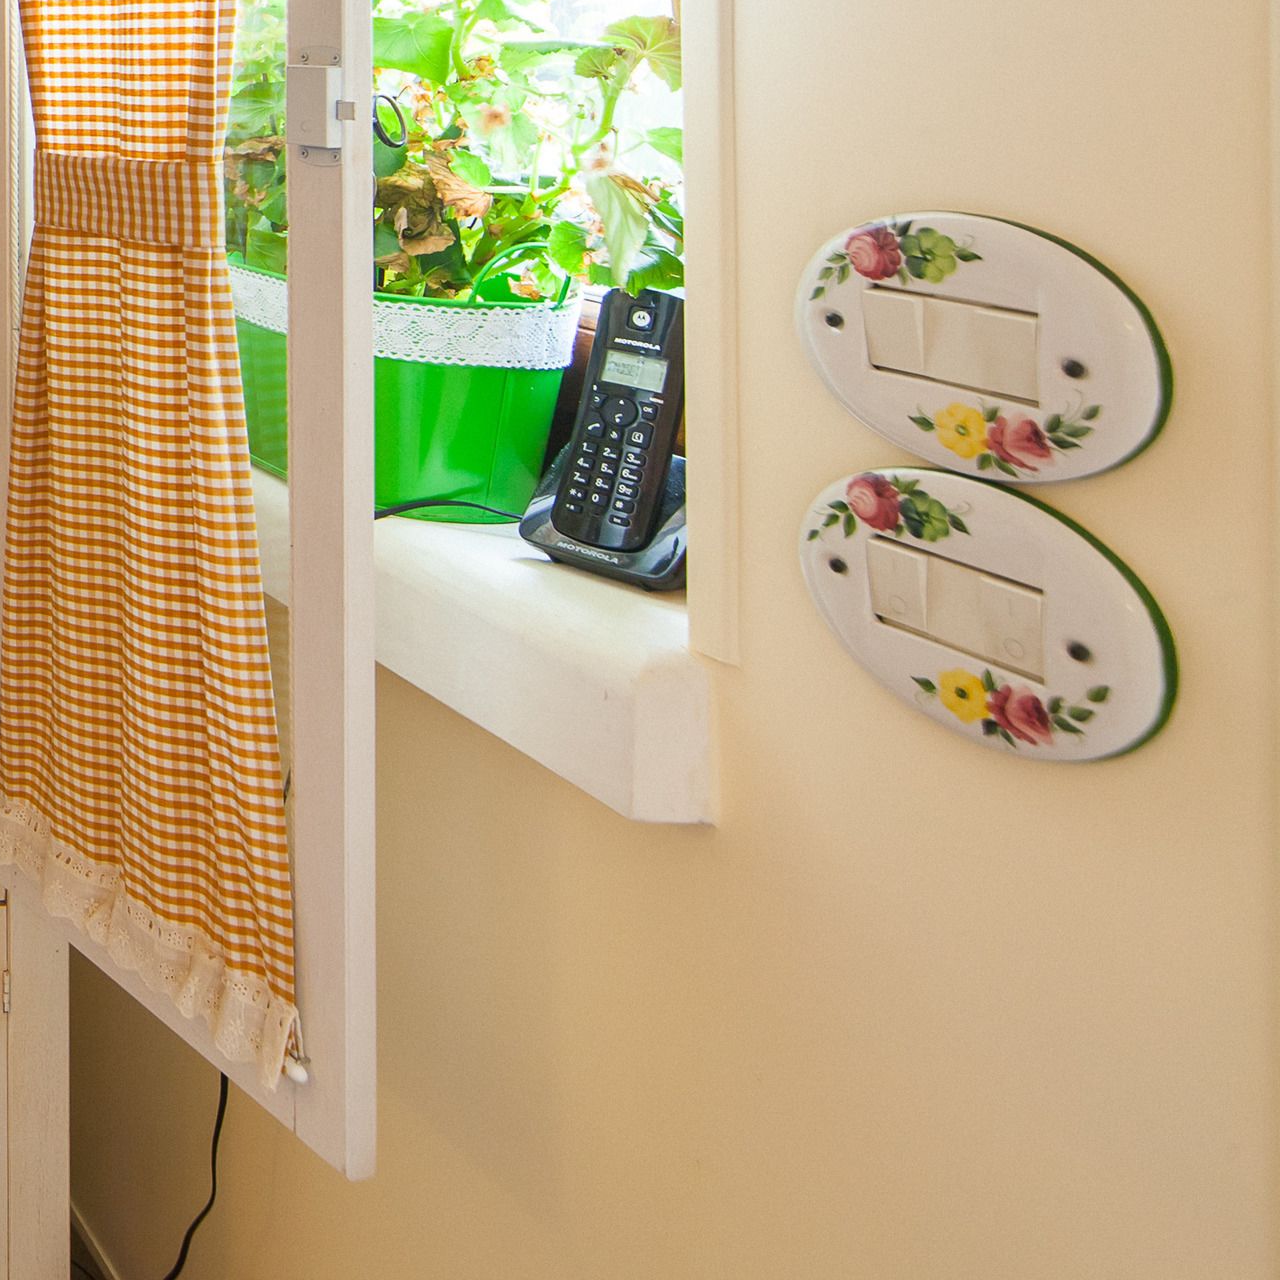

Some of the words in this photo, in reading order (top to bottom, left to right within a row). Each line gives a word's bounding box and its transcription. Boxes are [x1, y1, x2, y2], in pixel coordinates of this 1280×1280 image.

[613, 337, 662, 352] MOTOROLA
[642, 406, 654, 414] OK
[557, 541, 620, 564] MOTOROLA
